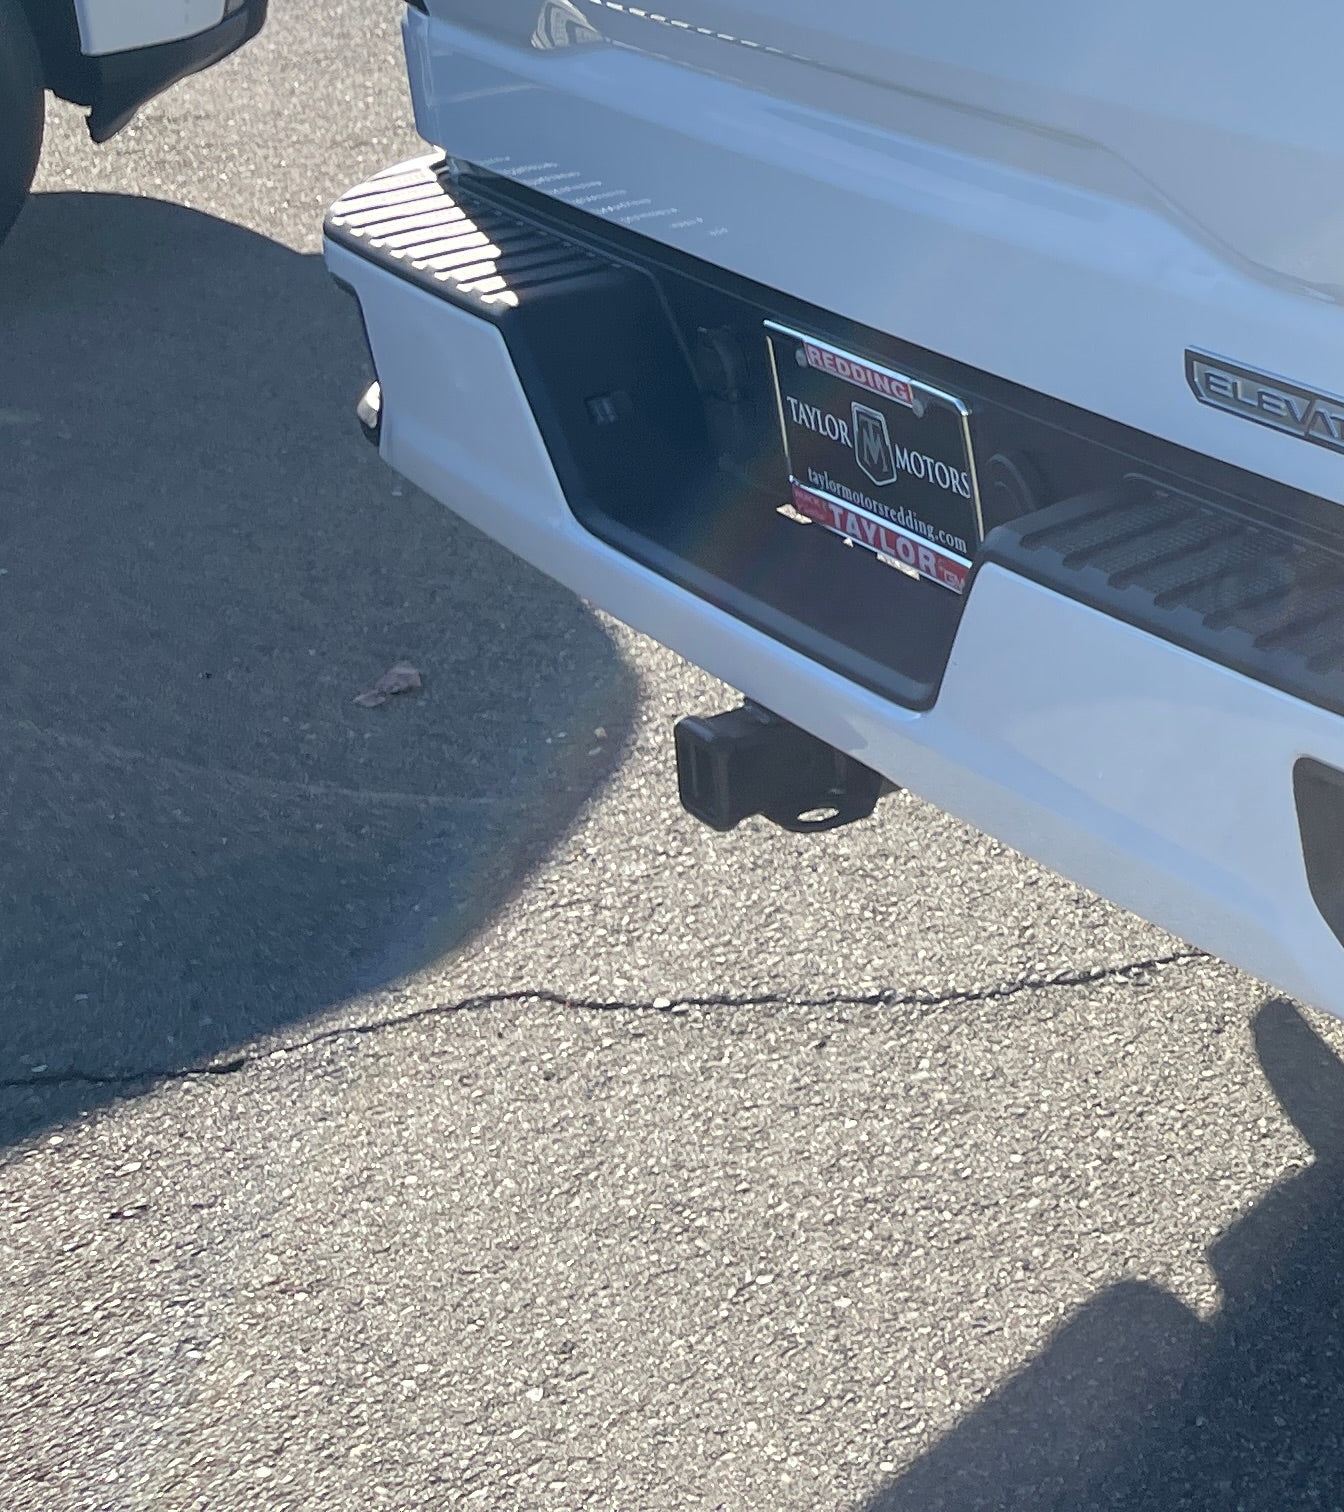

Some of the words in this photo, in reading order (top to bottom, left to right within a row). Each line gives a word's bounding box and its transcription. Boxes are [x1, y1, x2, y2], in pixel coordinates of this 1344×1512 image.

[807, 345, 910, 402] REDDING
[787, 396, 853, 448] TAYLOR
[895, 444, 971, 499] MOTORS
[807, 467, 967, 554] taylormotorsredding.com
[828, 503, 937, 577] TAYLOR
